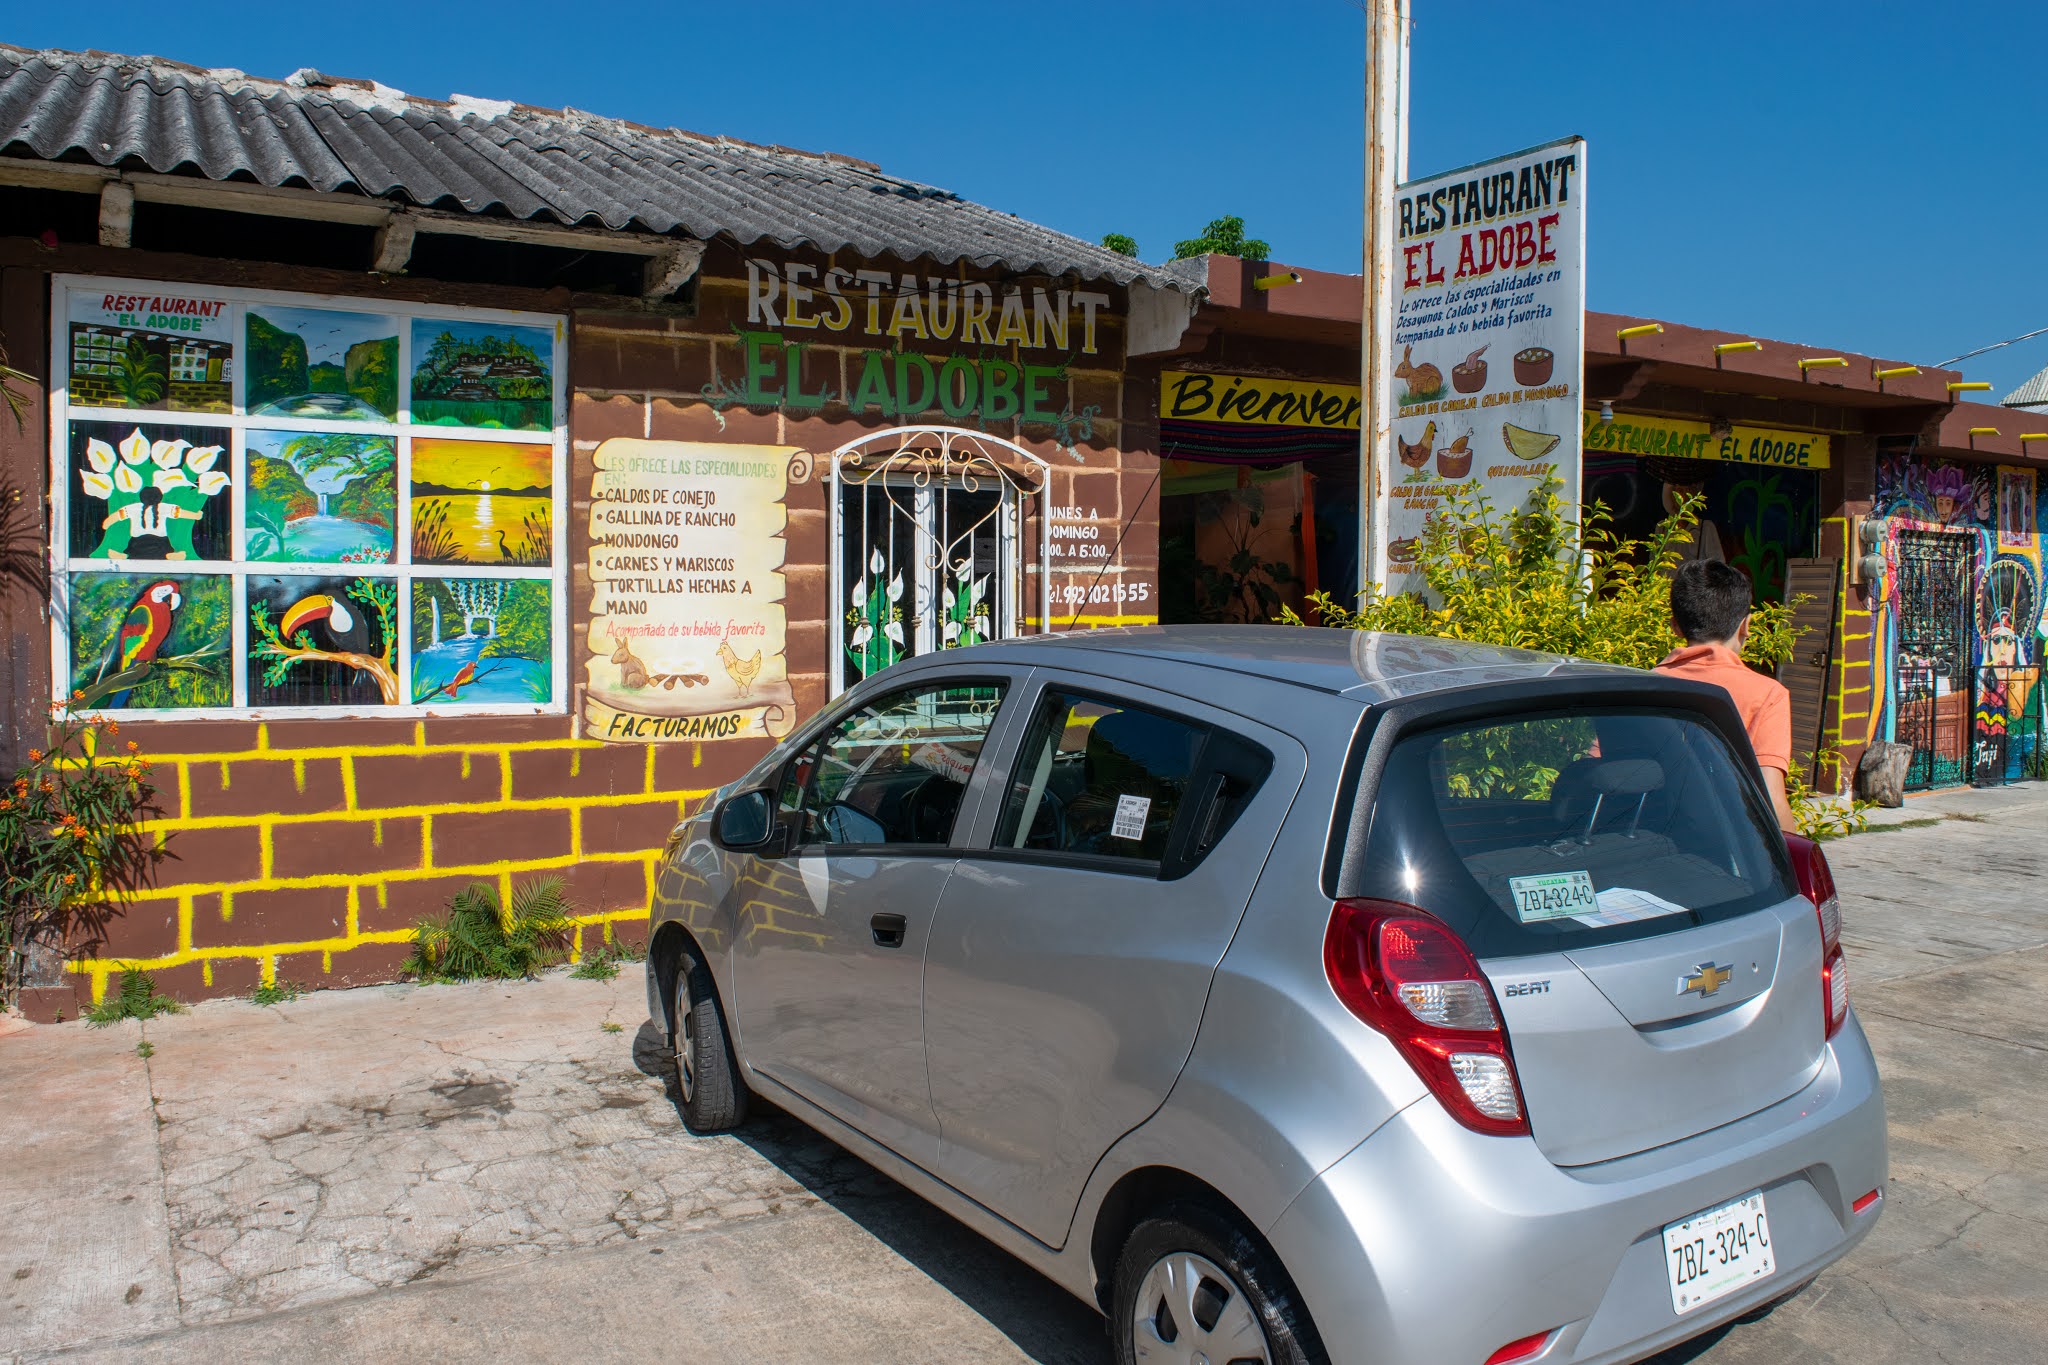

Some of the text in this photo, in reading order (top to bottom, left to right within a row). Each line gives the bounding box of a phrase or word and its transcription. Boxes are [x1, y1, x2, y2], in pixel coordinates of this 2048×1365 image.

[1398, 154, 1576, 243] RESTAURANT
[1403, 212, 1560, 295] EL ADOBE
[1399, 269, 1562, 314] Le ofrece las especialidades en
[102, 295, 227, 318] RESTAURANT
[744, 258, 1110, 354] RESTAURANT
[1446, 303, 1479, 320] Caldos
[1481, 302, 1488, 315] y
[1491, 292, 1535, 312] Mariscos
[1395, 325, 1445, 346] Acompañada
[1447, 323, 1457, 336] de
[1472, 315, 1505, 332] bebida
[1508, 304, 1553, 330] favorita
[740, 330, 1070, 426] EL ADOBE
[1481, 383, 1569, 408] CALDO DE MONDONGO
[1398, 397, 1478, 418] CALDO DE CONEJO
[1720, 437, 1743, 461] EL
[628, 457, 668, 474] OFRECE
[671, 459, 691, 475] LAS
[695, 460, 778, 479] ESPECIALIDADES
[605, 488, 716, 509] CALDOS DE CONEJO
[605, 509, 736, 528] GALLINA DE RANCHO
[1049, 506, 1099, 520] UNES A
[605, 533, 679, 549] MONDONGO
[1067, 544, 1077, 557] A
[605, 556, 735, 573] CARNES Y MARISCOS
[606, 578, 753, 595] TORTILLAS HECHAS A
[606, 600, 648, 615] MANO
[605, 619, 767, 642] Acompañada de su bebida favorita
[607, 713, 741, 739] FACTURAMOS
[1519, 885, 1593, 912] ZBZ-324-C
[1504, 980, 1551, 998] BEAT
[1672, 1213, 1768, 1286] ZBZ-324-C
